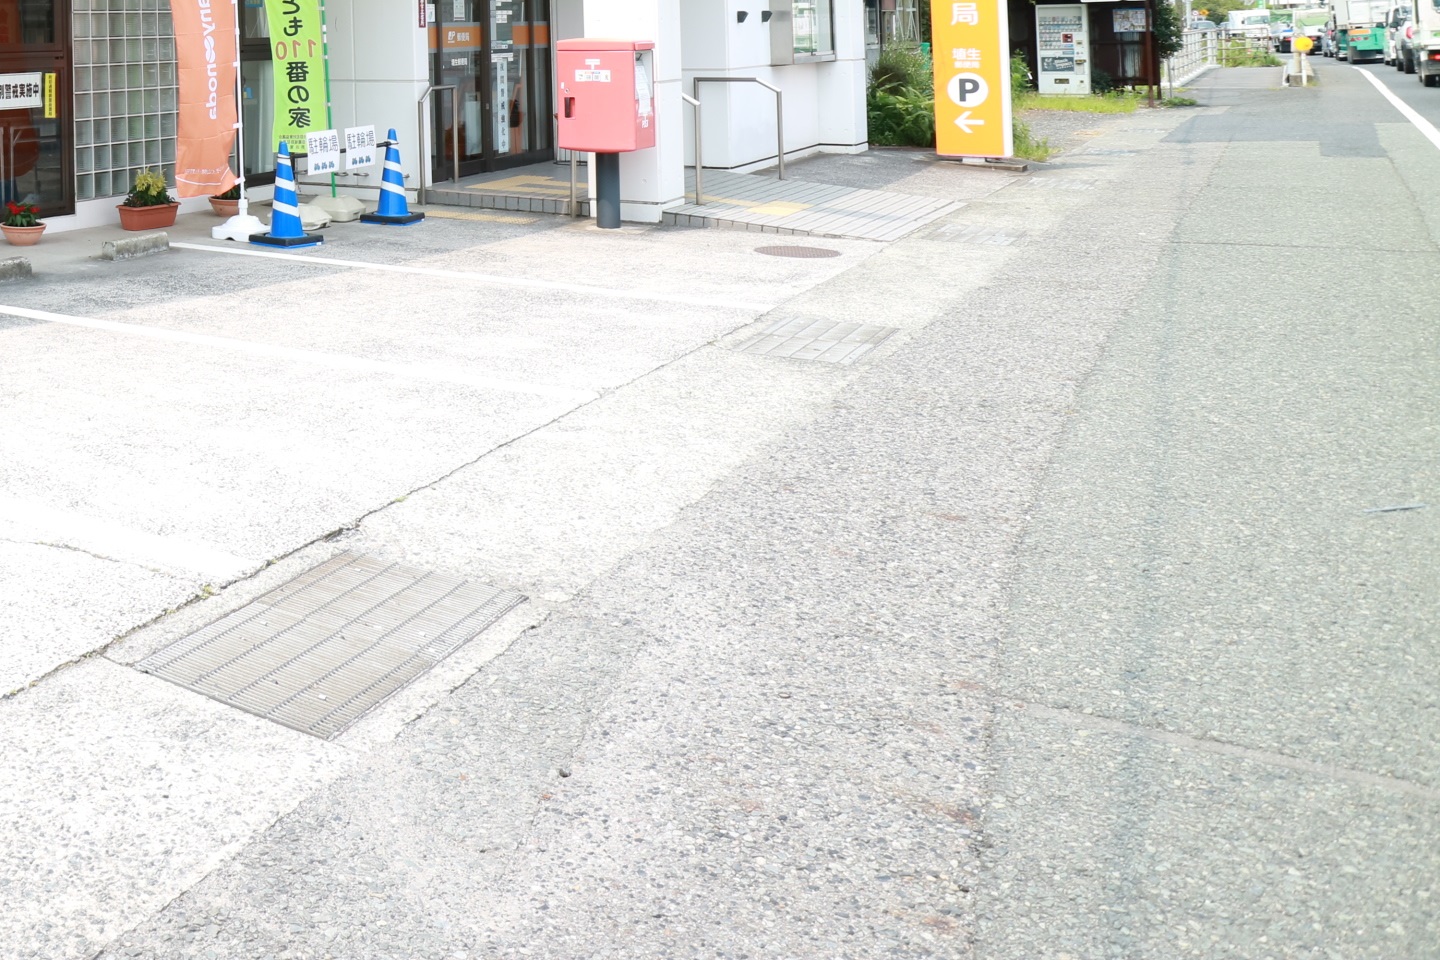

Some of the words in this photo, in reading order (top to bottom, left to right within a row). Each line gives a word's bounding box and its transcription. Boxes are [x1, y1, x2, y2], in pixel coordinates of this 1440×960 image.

[958, 78, 980, 102] P
[308, 134, 339, 155] 駐輪場
[346, 129, 375, 151] 駐輪場
